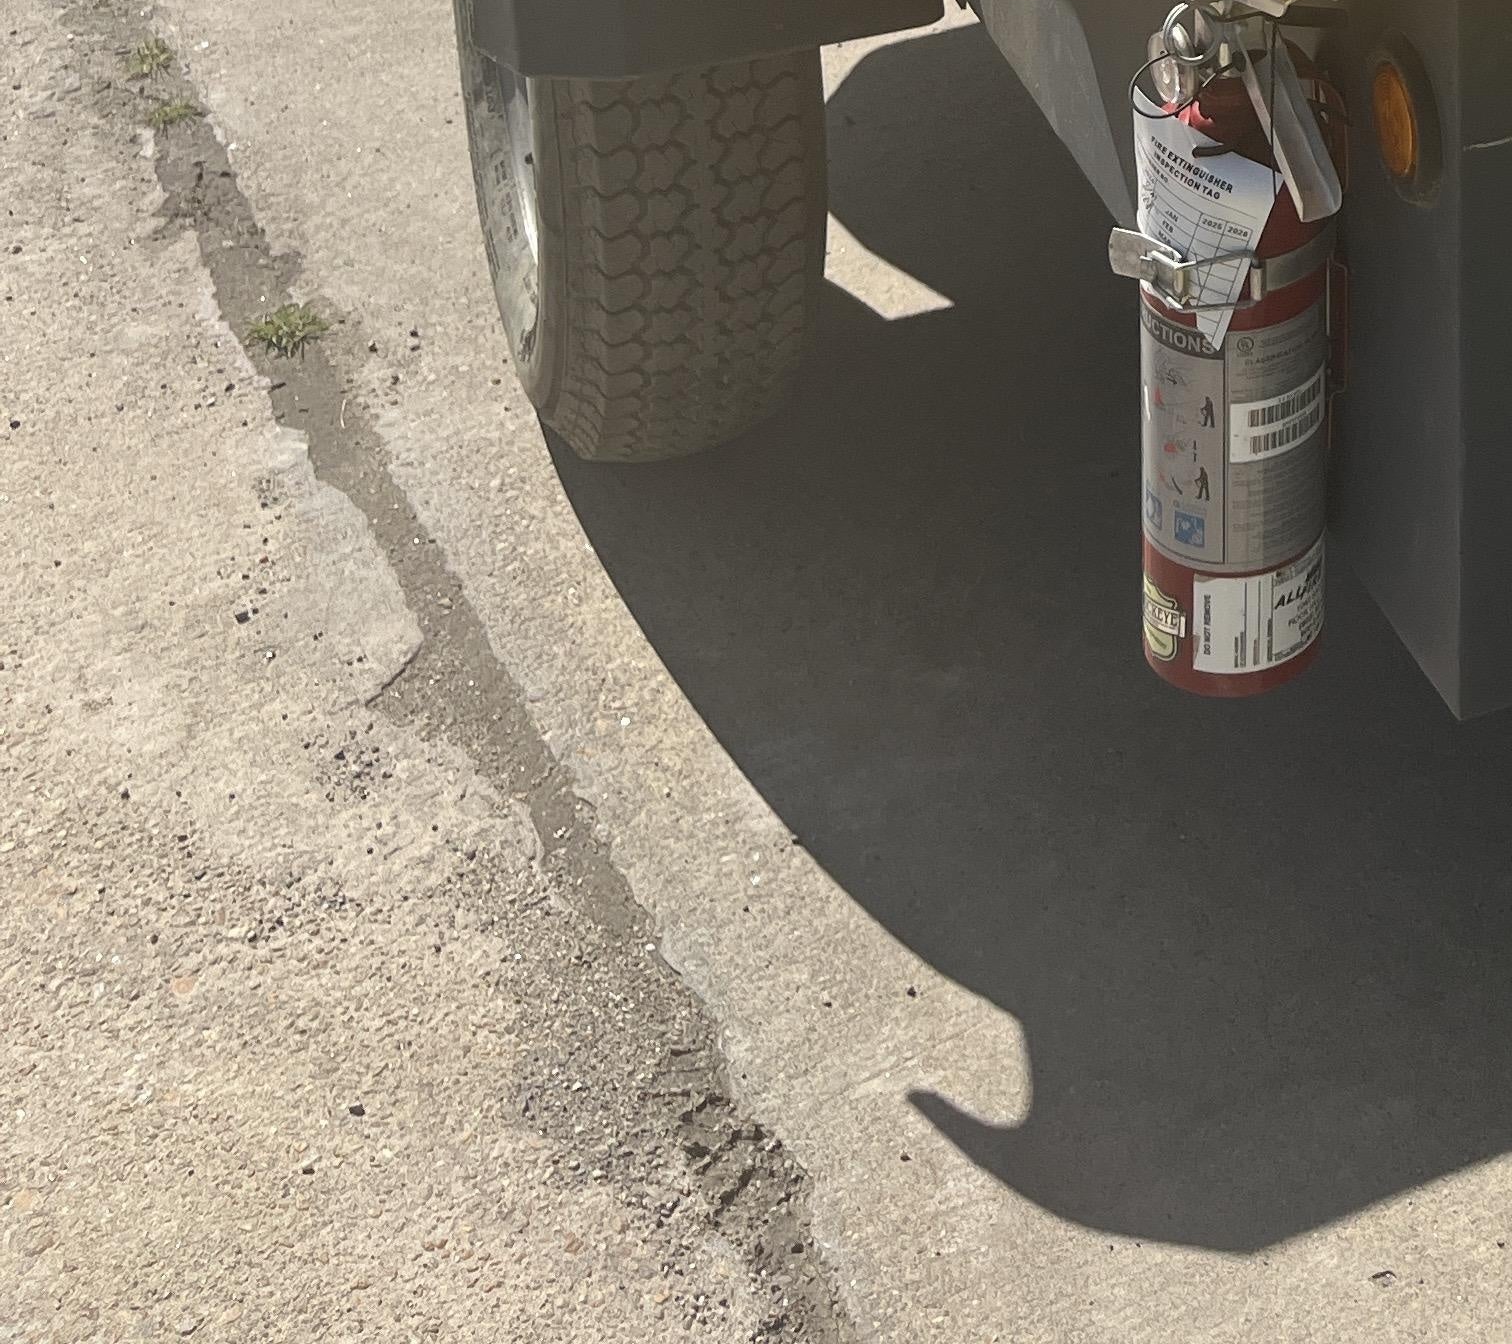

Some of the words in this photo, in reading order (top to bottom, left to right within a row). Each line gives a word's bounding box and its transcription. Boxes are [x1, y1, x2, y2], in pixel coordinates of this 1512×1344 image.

[1151, 135, 1168, 155] FIRE
[1167, 151, 1234, 194] EXTINGUISHER
[1154, 151, 1202, 191] INSPECTION
